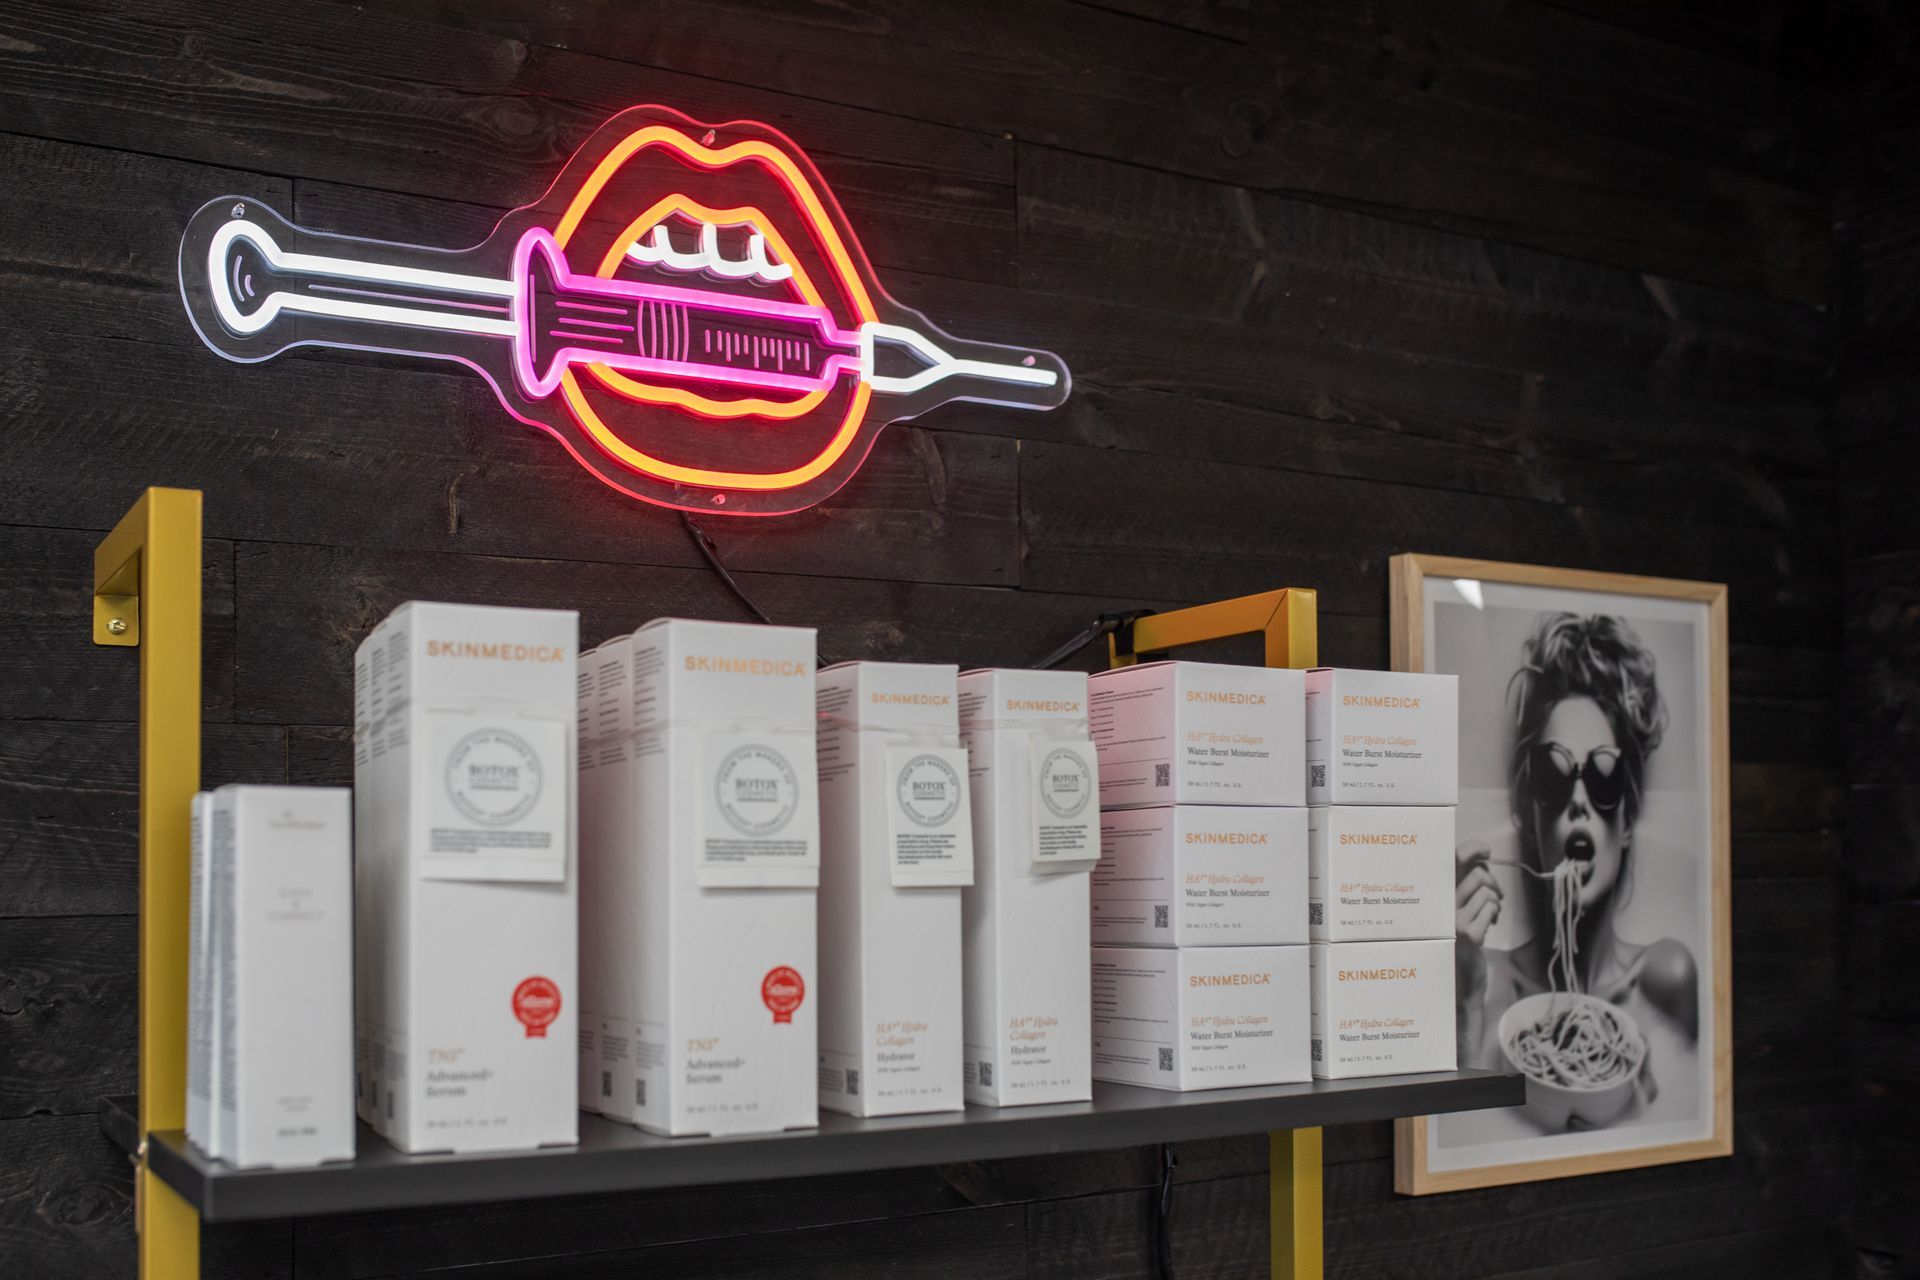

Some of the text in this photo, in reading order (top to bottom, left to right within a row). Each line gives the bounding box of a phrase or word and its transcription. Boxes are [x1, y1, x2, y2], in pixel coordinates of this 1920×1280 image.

[1187, 747, 1270, 758] Water Burst Moisturizer
[1342, 749, 1422, 759] Water Burst Moisturizer
[1185, 833, 1268, 845] SKINMEDICA
[1339, 834, 1418, 845] SKINMEDICA
[1186, 889, 1270, 897] Water Burst Moisturizer
[1340, 897, 1420, 905] Water Burst Moisturizer
[1190, 973, 1271, 987] SKINMEDICA
[1338, 968, 1417, 982] SKINMEDICA
[1190, 1029, 1274, 1040] Water Burst Moisturizer
[1339, 1031, 1420, 1042] Water Burst Moisturizer
